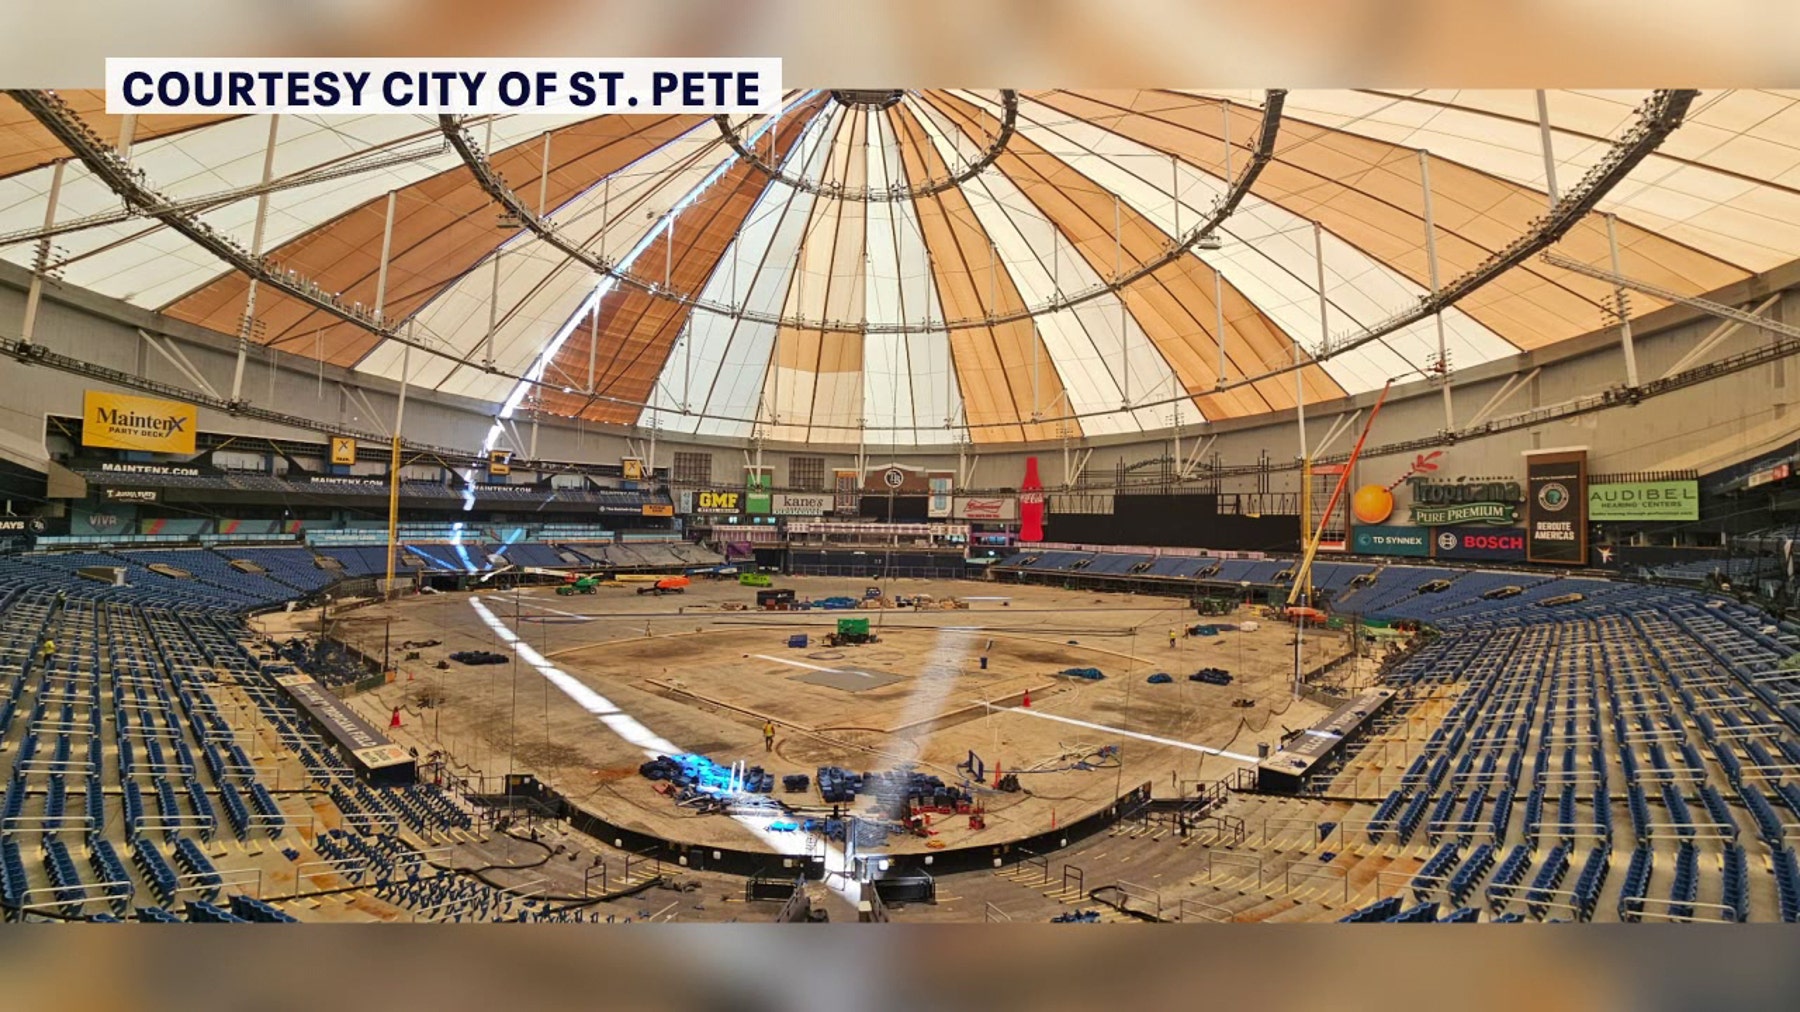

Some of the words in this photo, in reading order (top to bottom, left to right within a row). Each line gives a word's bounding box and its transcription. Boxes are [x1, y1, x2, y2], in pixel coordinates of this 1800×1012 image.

[96, 407, 187, 438] MaintenX
[109, 426, 138, 435] PARTY
[141, 430, 164, 438] DECK
[102, 463, 199, 476] MAINTENX.COM
[310, 477, 384, 487] MAINTENX.COM
[1406, 476, 1521, 504] Tropicana
[1590, 488, 1697, 502] AUDIBEL
[699, 493, 738, 508] GMF
[1416, 511, 1446, 523] PURE
[1447, 505, 1504, 521] PREMIUM
[1536, 522, 1572, 531] REROUTE
[1372, 536, 1384, 544] TD
[1386, 536, 1423, 545] SYNNEX
[1463, 535, 1523, 549] BOSCH
[1534, 531, 1575, 540] AMERICAS
